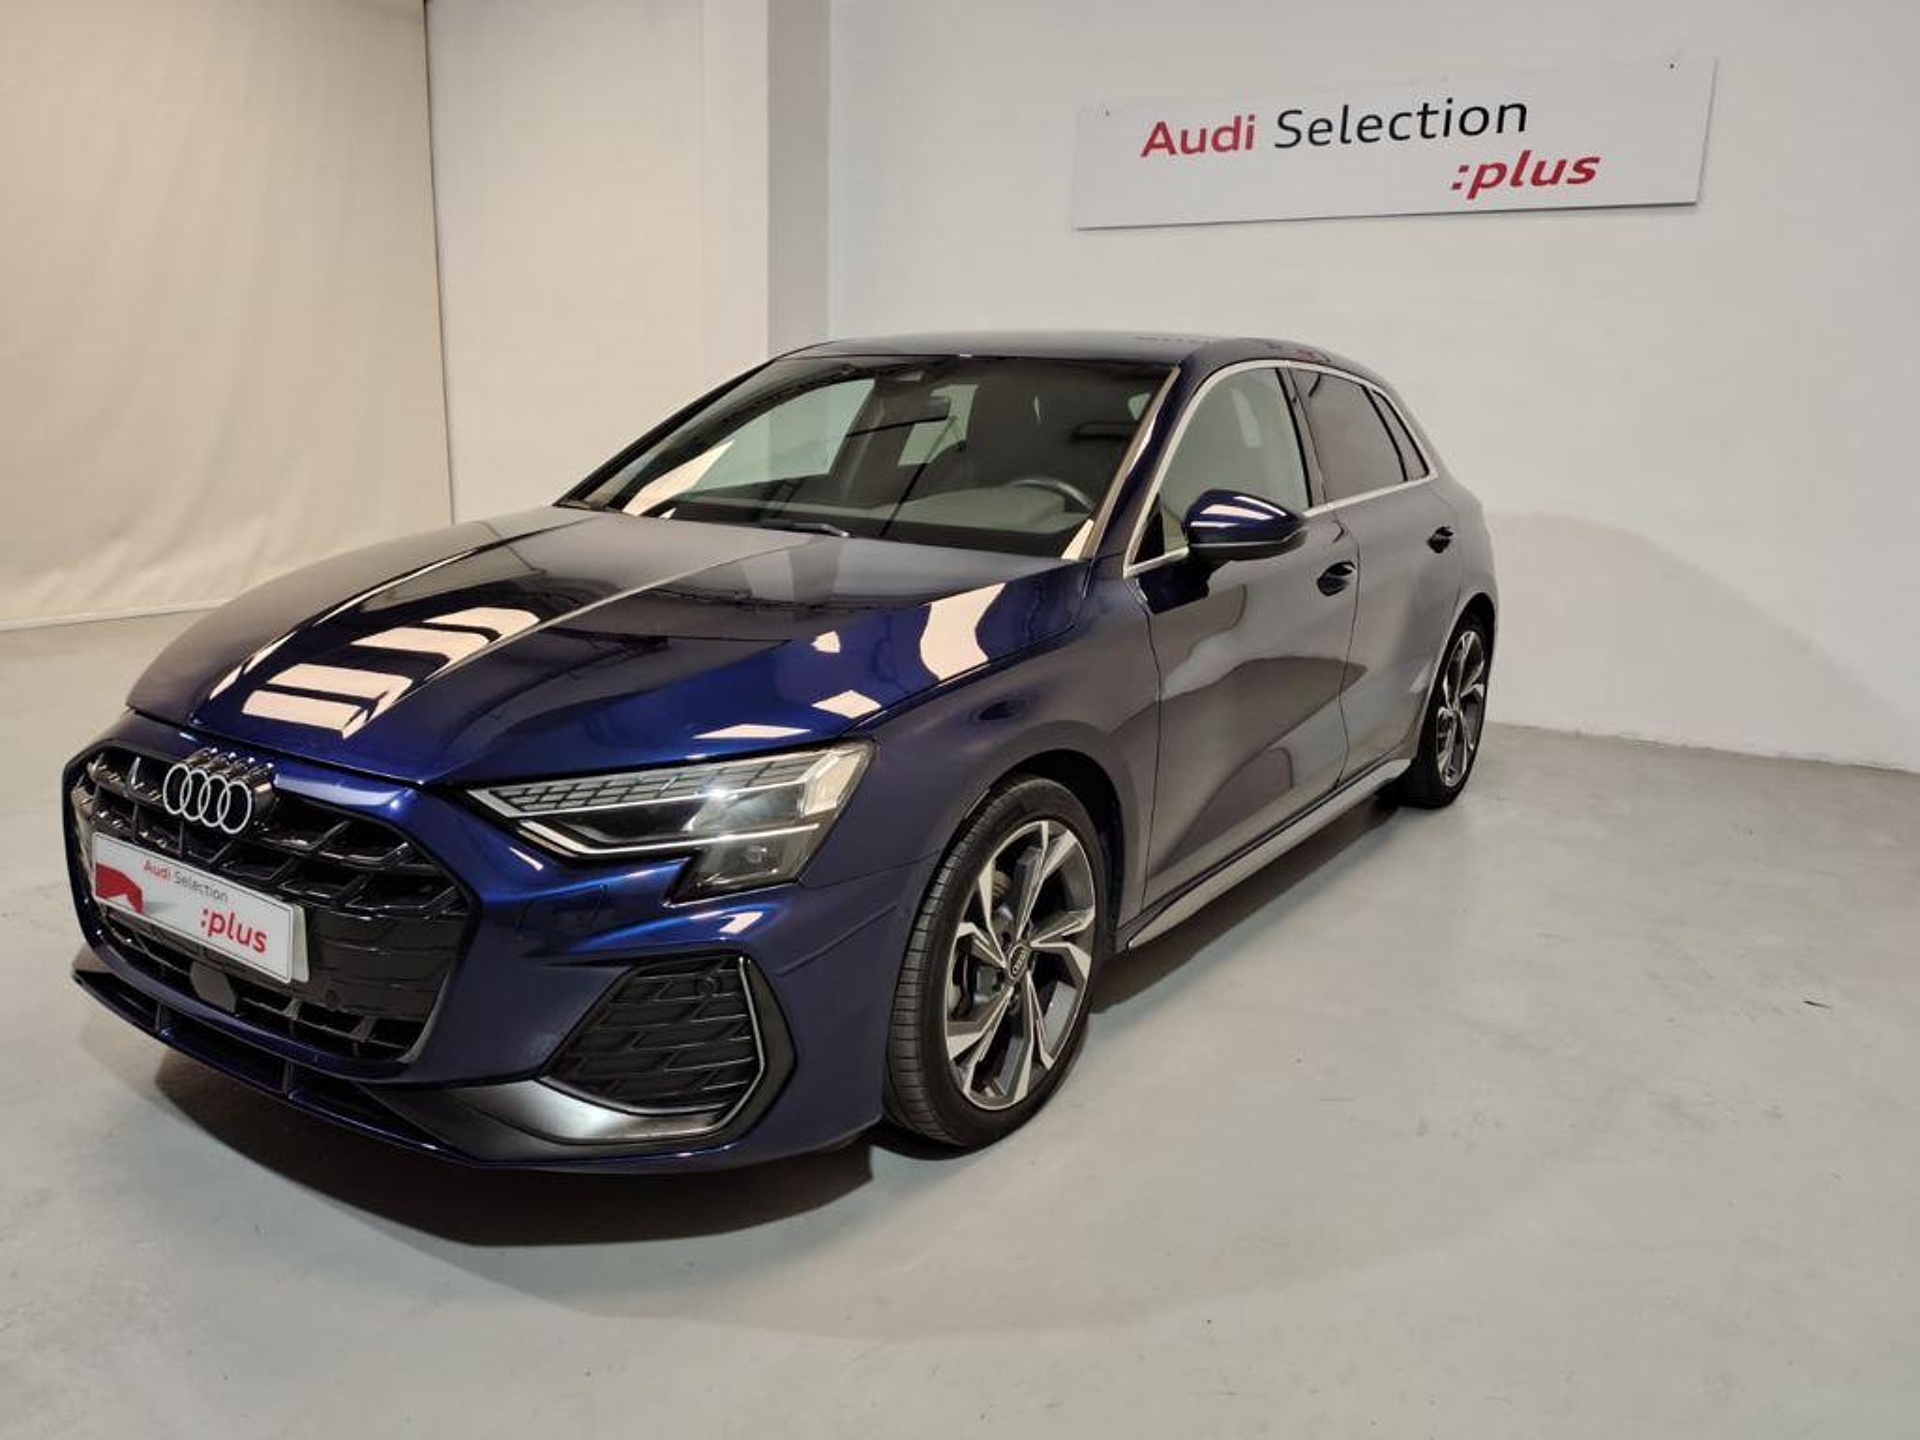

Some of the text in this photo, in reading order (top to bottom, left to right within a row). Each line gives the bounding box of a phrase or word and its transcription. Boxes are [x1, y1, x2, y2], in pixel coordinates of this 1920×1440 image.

[1141, 98, 1528, 157] Audi Selection
[1450, 150, 1600, 198] :plus
[143, 860, 228, 902] Audi Selection
[201, 908, 267, 953] :plus
